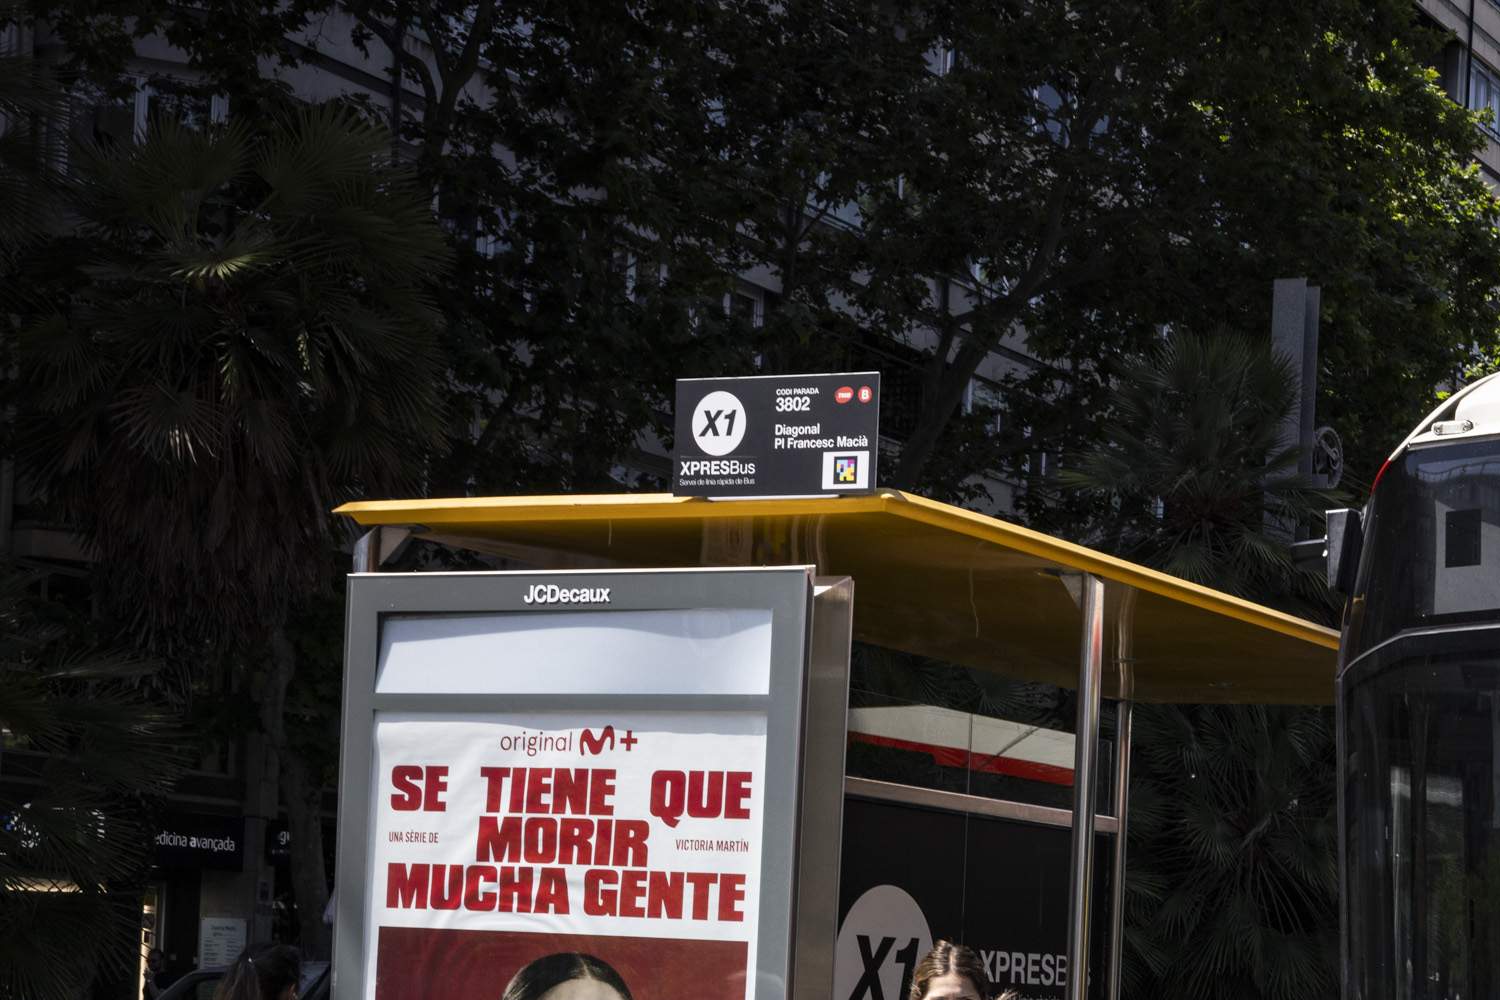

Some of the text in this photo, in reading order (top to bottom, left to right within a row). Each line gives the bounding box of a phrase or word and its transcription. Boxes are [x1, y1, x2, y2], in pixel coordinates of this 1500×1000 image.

[793, 387, 819, 395] PARADA
[775, 396, 810, 412] 3802
[699, 409, 737, 437] X1
[775, 423, 820, 436] Diagonal
[787, 436, 834, 449] Francesc
[836, 435, 868, 448] Macià
[680, 460, 756, 476] XPRESBus
[743, 477, 755, 485] Bus
[524, 585, 610, 603] JCDecaux
[500, 731, 573, 756] original
[391, 765, 753, 828] SE TIENE QUE
[189, 836, 235, 852] avançada
[389, 831, 403, 842] UNA
[429, 832, 439, 843] DE
[476, 816, 650, 868] MORIR
[675, 837, 749, 853] VICTORIA MARTÍN
[386, 862, 746, 922] MUCHA GENTE
